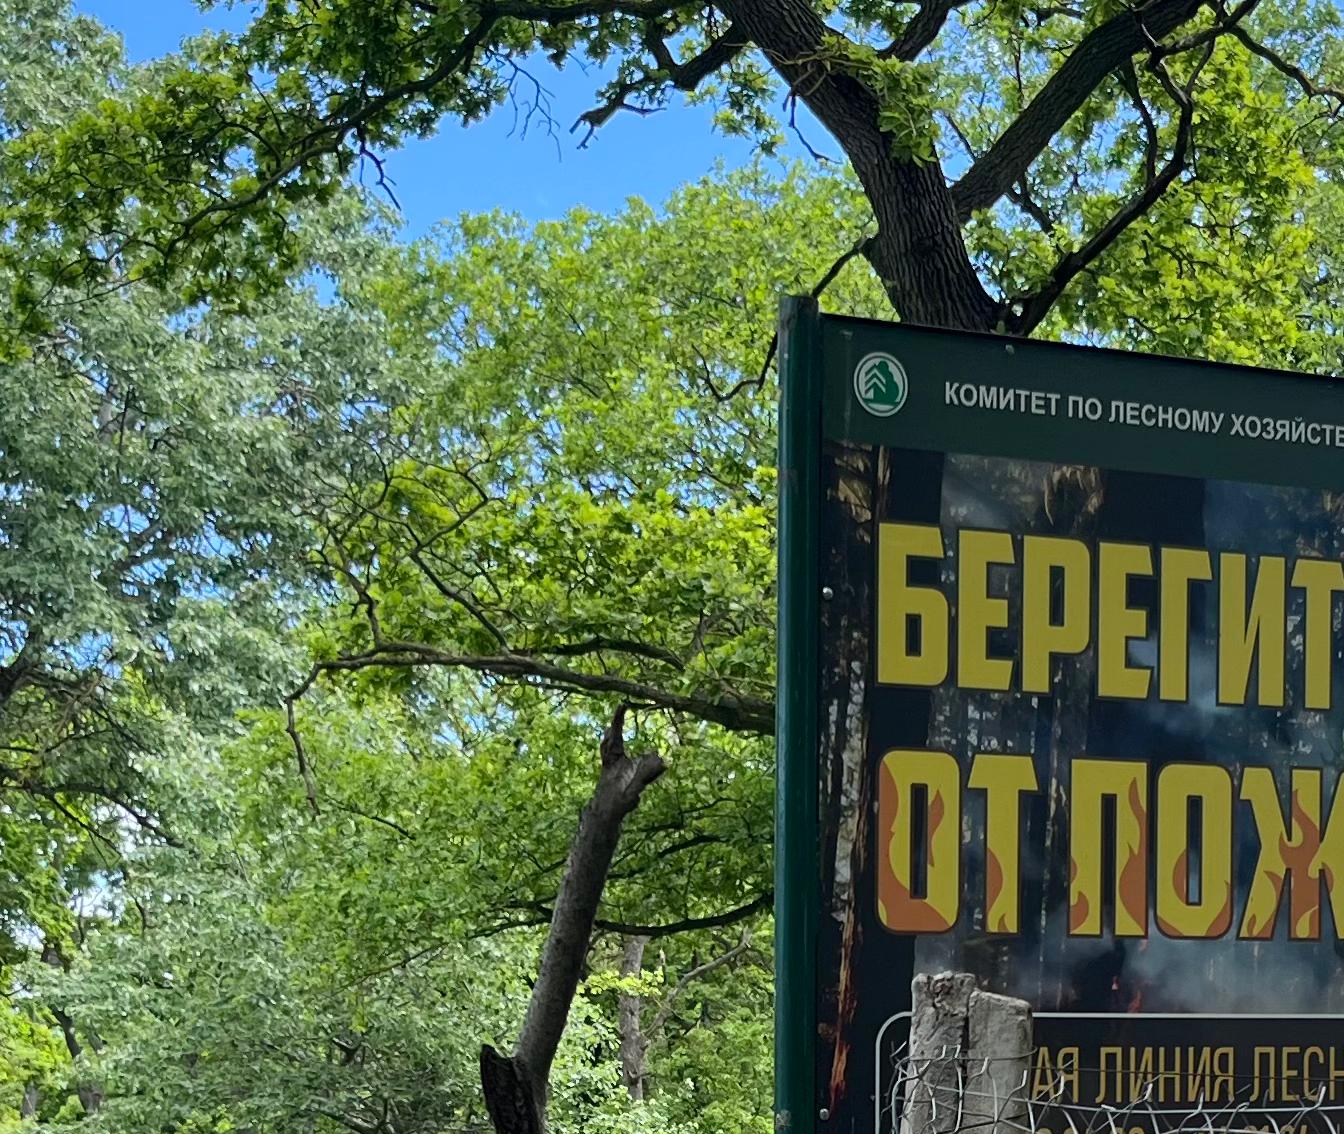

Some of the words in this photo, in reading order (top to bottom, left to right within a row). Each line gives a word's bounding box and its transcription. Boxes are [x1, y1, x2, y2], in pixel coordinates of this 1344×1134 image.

[945, 381, 1060, 417] КОМИТЕТ
[1068, 395, 1102, 421] ПО
[1109, 400, 1225, 435] ЛЕСНОМУ
[877, 749, 1039, 935] ОТ
[1095, 1046, 1234, 1103] ЛИНИЯ
